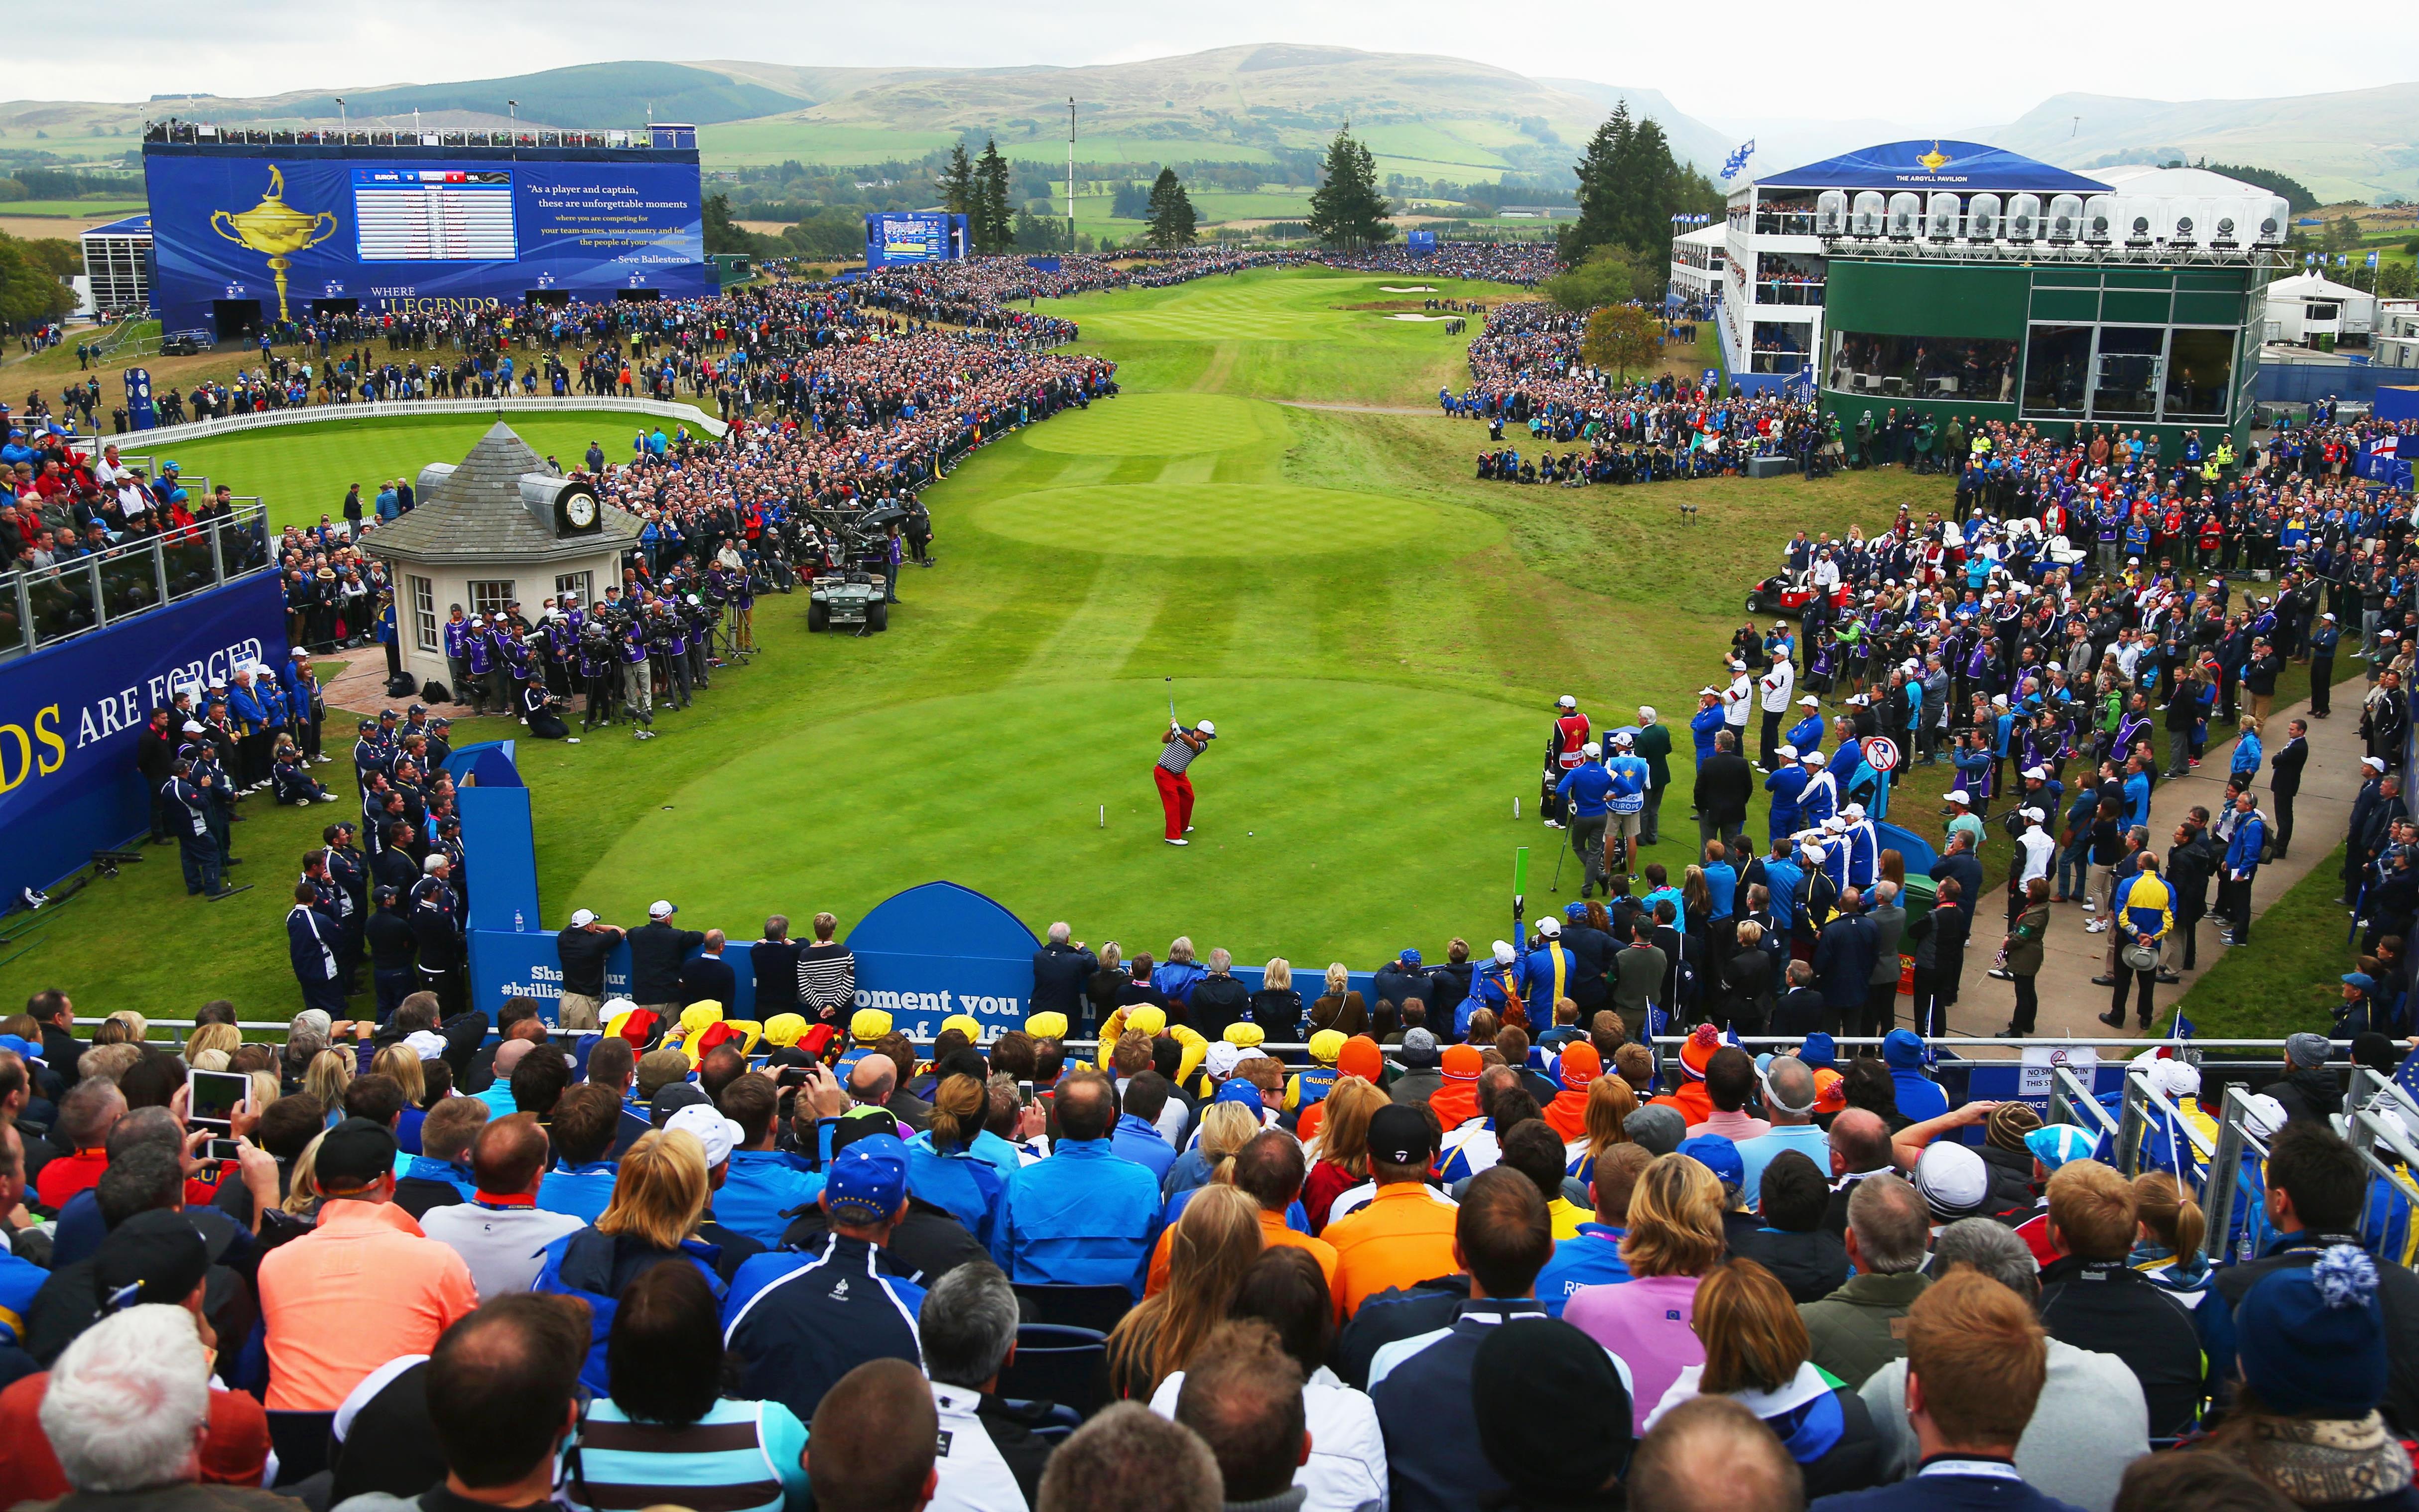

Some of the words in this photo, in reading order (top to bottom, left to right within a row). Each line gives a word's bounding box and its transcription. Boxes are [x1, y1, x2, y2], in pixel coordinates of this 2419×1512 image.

[552, 184, 581, 195] player
[583, 185, 600, 194] and
[602, 186, 638, 196] captain,
[539, 199, 563, 208] these
[582, 199, 643, 210] unforgettable
[641, 255, 690, 263] Ballesteros
[371, 287, 415, 296] WHERE
[390, 297, 497, 315] LEGENDS
[77, 686, 141, 749] ARE
[1612, 801, 1640, 810] EUROPE
[531, 965, 564, 981] Sha
[854, 989, 952, 1013] oment
[959, 994, 1019, 1018] you
